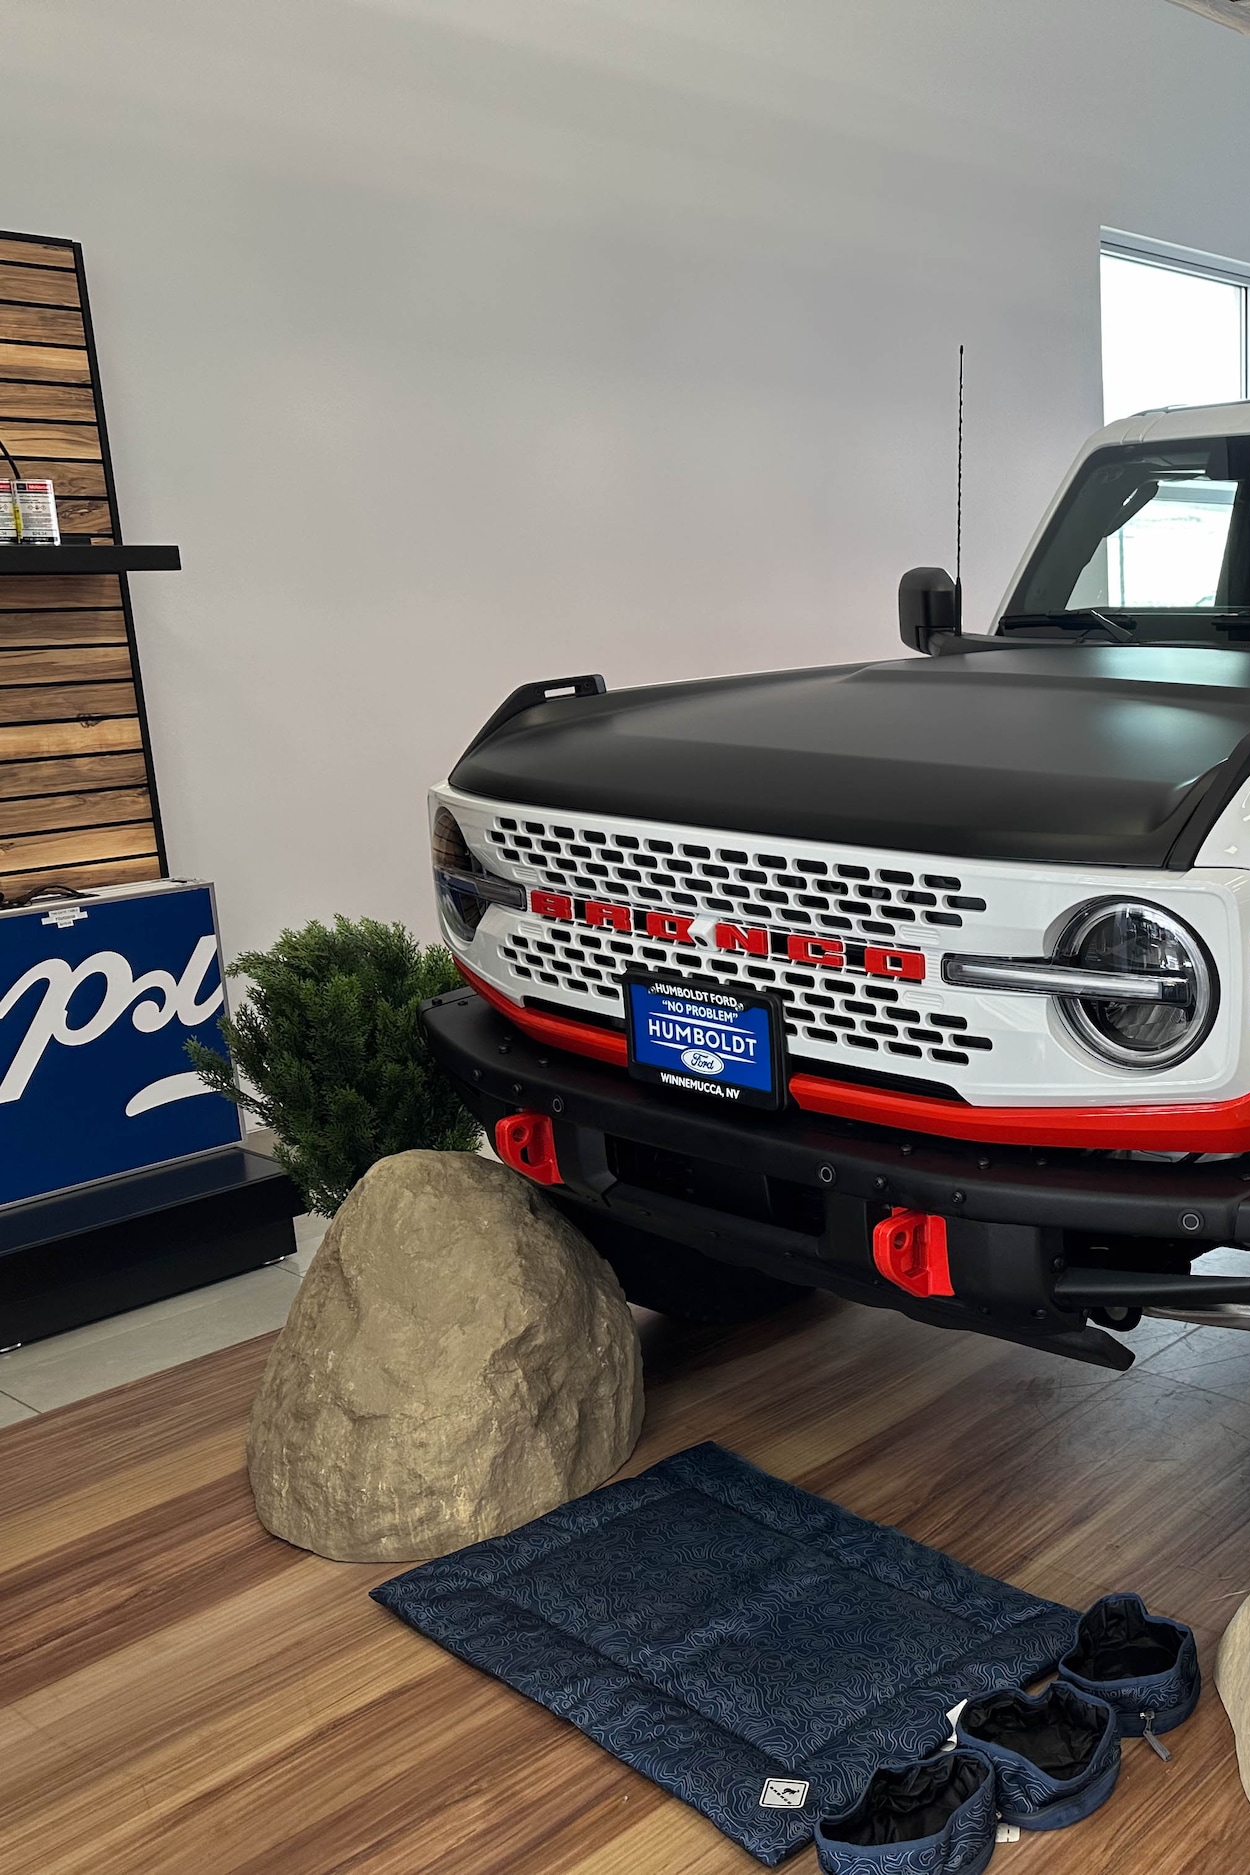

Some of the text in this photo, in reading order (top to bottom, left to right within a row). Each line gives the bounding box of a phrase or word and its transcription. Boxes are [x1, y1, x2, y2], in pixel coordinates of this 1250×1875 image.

[530, 889, 926, 980] BRONCO
[655, 983, 738, 1008] HUMBOLDT FORD
[648, 1019, 757, 1057] HUMBOLDT
[691, 1052, 714, 1070] Ford
[660, 1072, 741, 1100] WINNEMUCCA, NV
